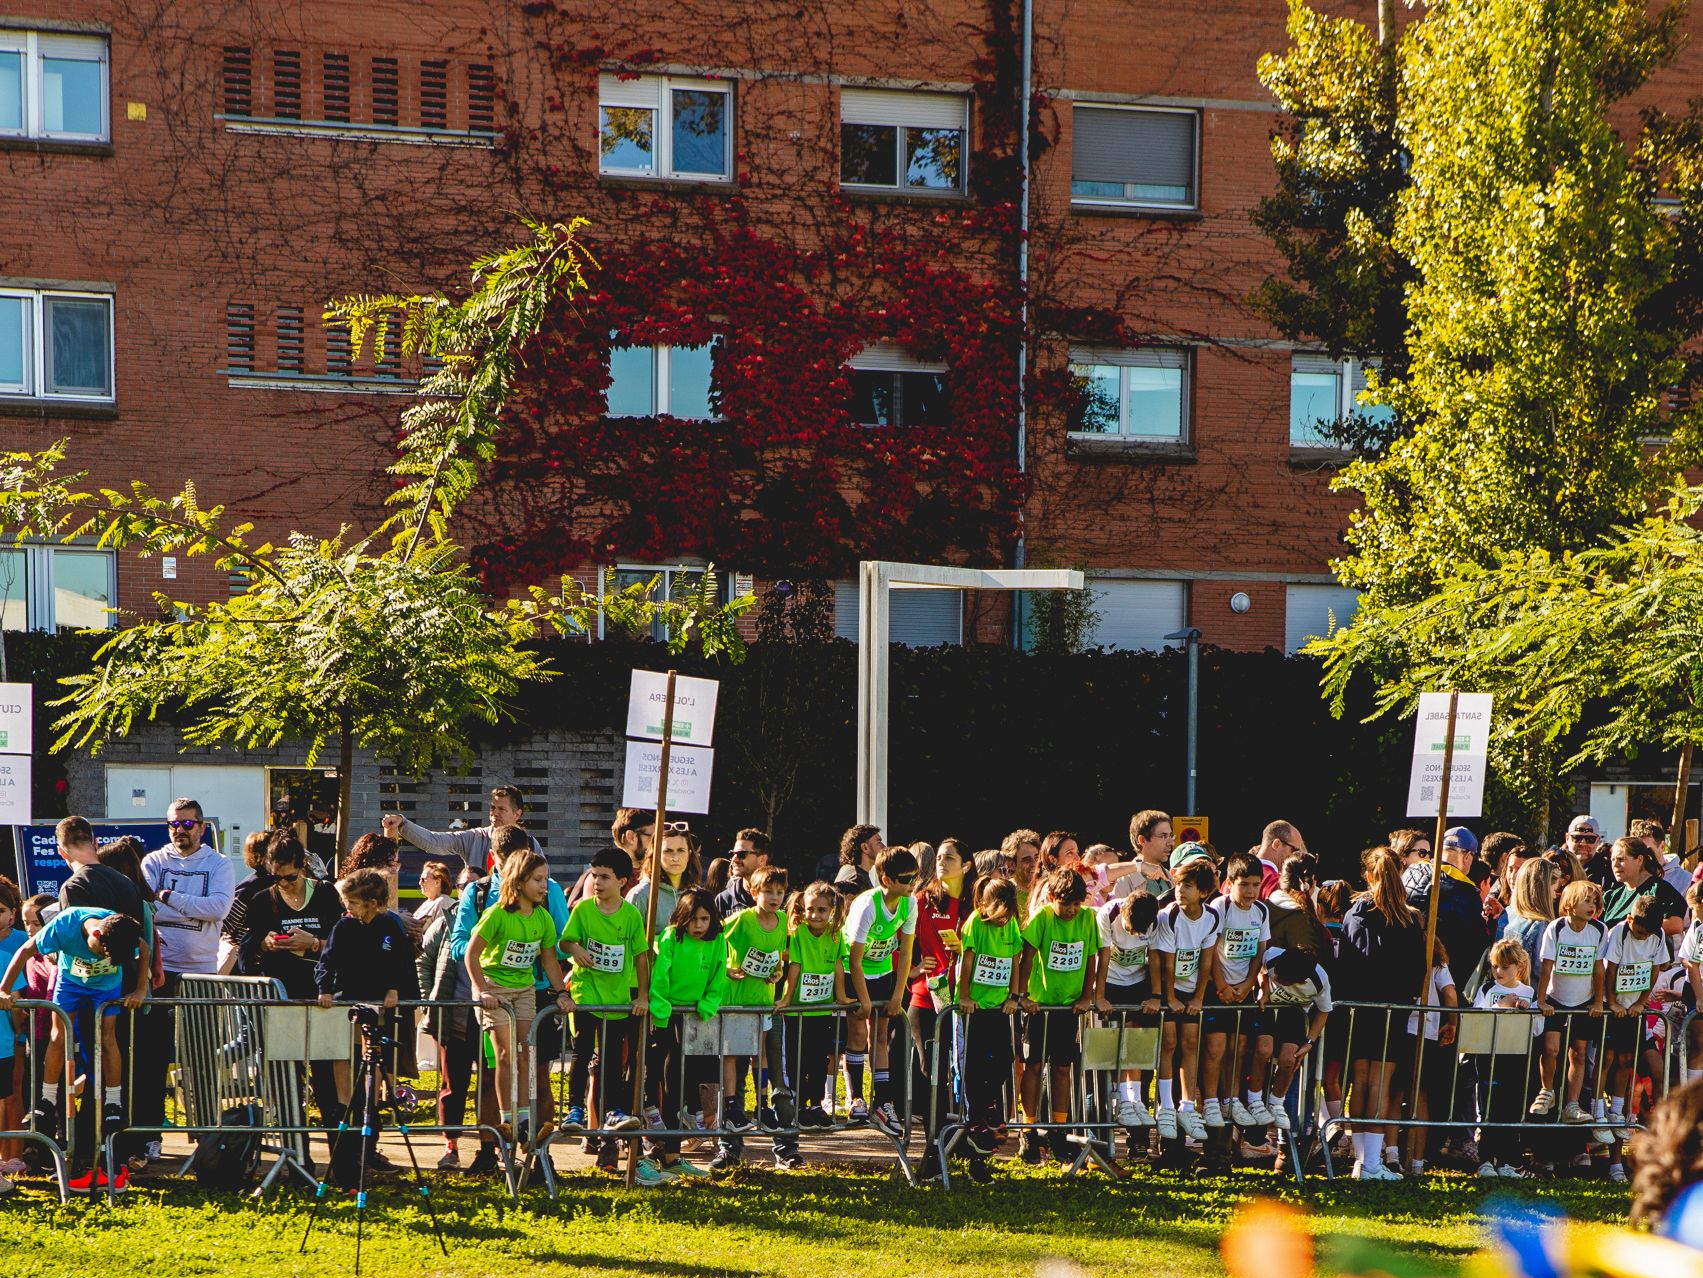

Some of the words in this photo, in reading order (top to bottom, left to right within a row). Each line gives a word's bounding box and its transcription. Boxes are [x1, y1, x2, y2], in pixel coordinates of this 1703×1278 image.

[32, 836, 58, 845] Cad
[33, 847, 54, 856] Fes
[35, 859, 68, 868] respo
[507, 955, 534, 963] 4076
[590, 954, 618, 967] 2289
[1052, 956, 1078, 965] 2290
[1561, 960, 1588, 968] 2732
[980, 970, 1007, 980] 2294
[1621, 977, 1646, 986] 2729
